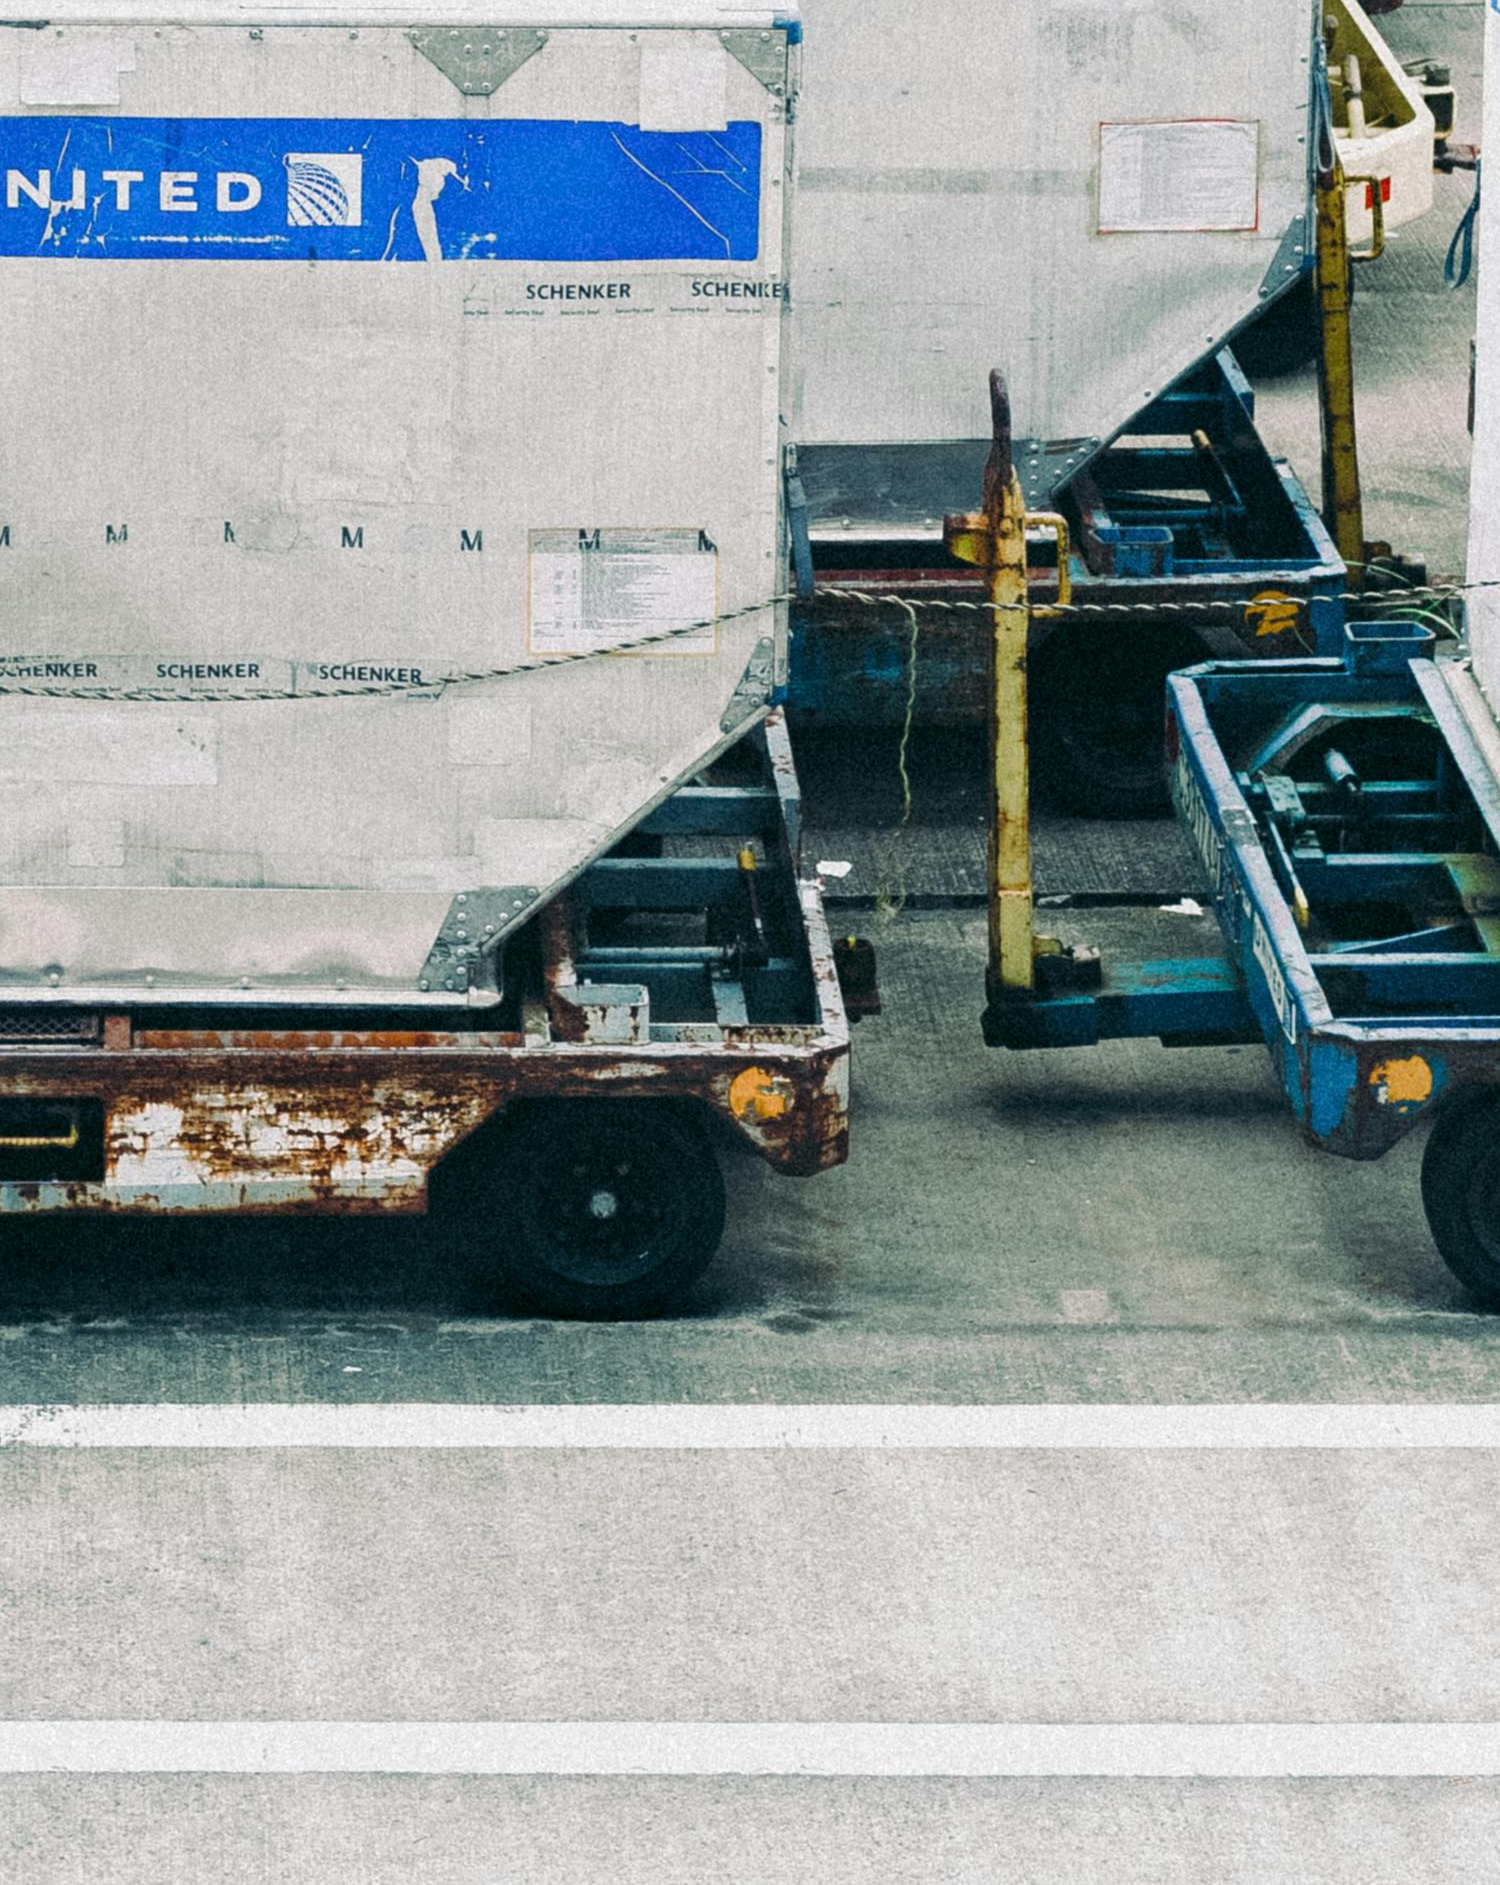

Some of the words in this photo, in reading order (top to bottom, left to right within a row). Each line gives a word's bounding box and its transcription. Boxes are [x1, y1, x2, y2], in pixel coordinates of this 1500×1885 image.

[526, 283, 631, 300] SCHENKER
[691, 281, 786, 300] SCHENKE
[342, 526, 364, 548] M
[156, 663, 260, 680] SCHENKER
[318, 666, 423, 684] SCHENKER
